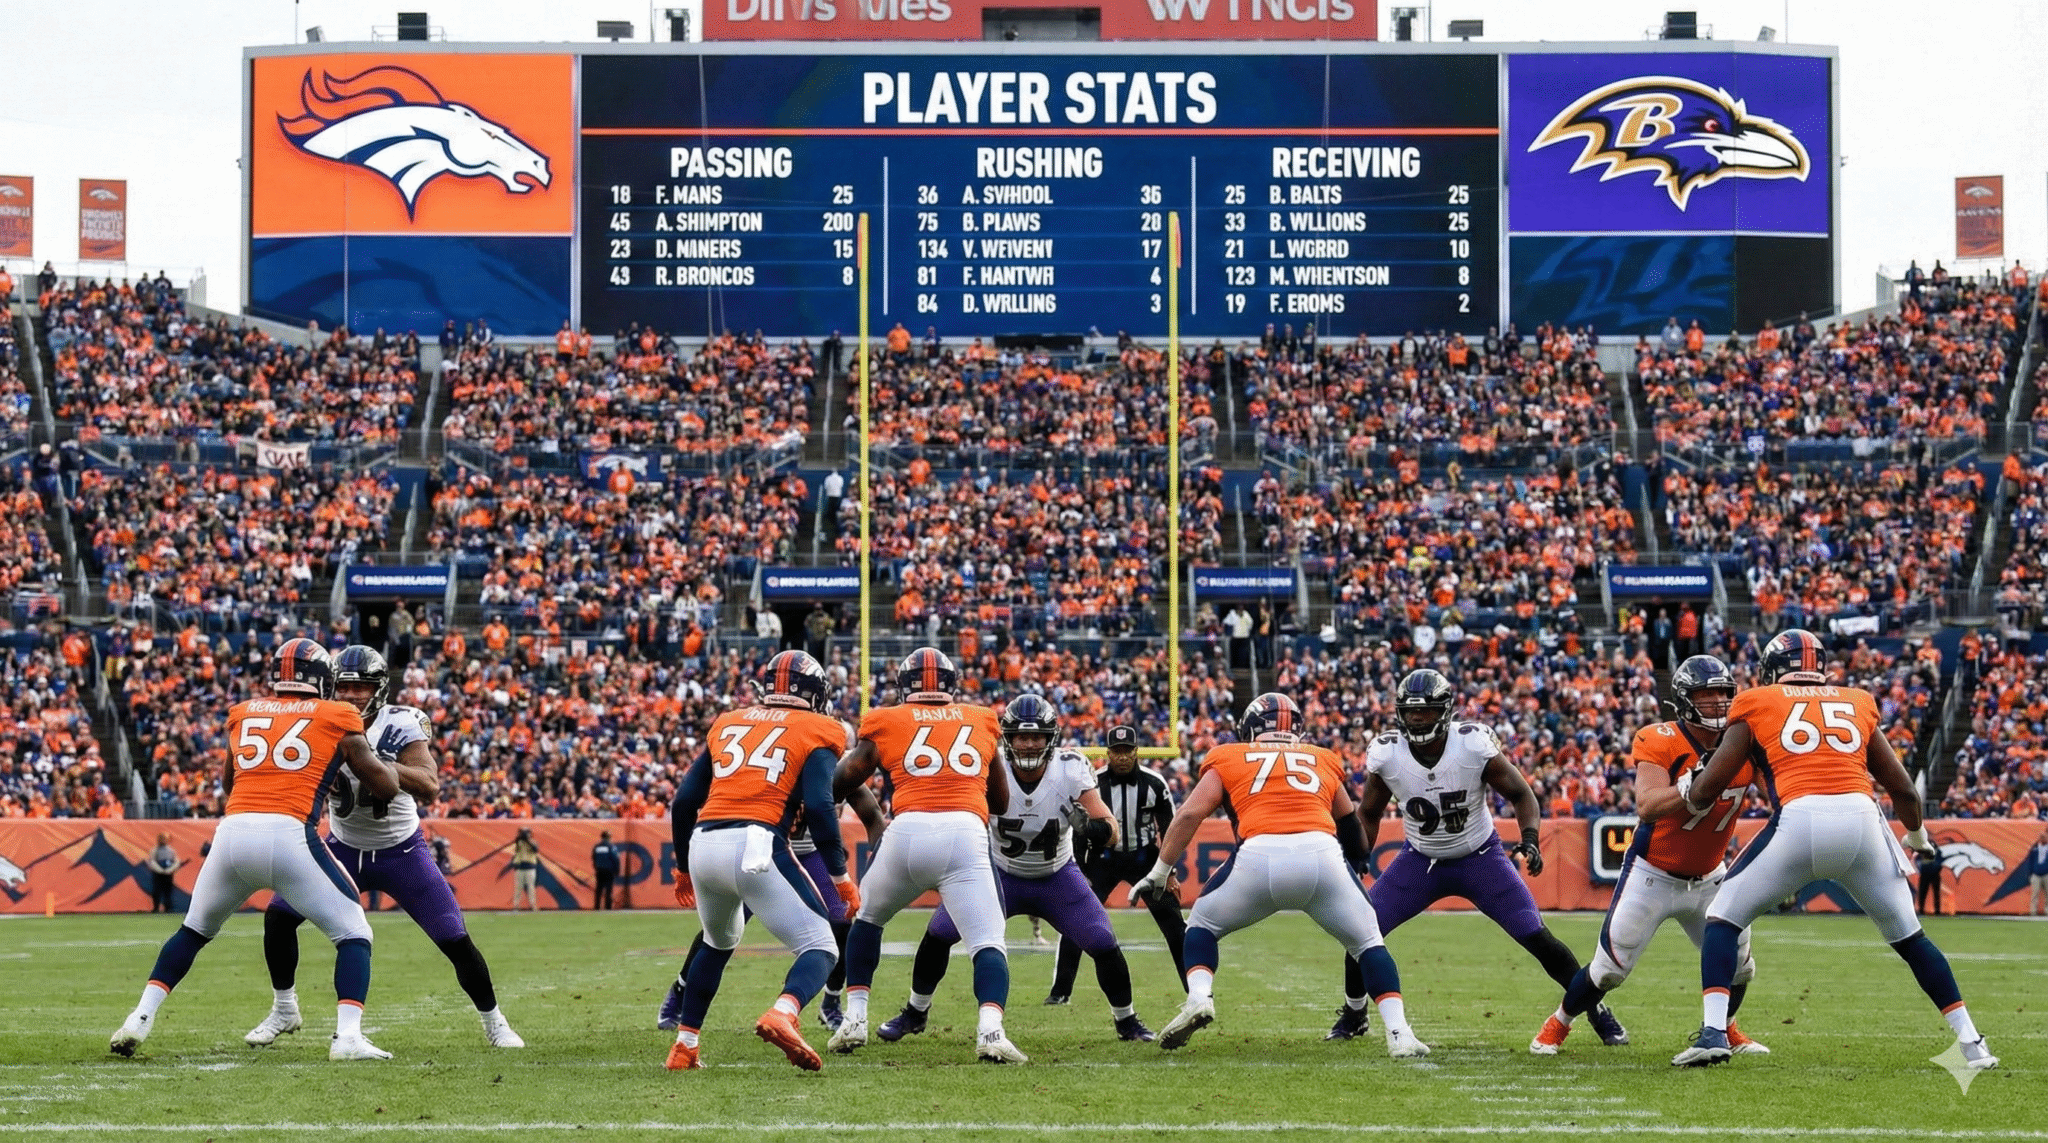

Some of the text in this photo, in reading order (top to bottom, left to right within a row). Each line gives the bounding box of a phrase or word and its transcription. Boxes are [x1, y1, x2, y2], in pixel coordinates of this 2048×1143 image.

[862, 71, 1218, 125] PLAYER STATS
[1598, 93, 1683, 147] B
[670, 146, 793, 179] PASSING
[977, 146, 1103, 178] RUSHING
[1272, 146, 1421, 178] RECEIVING
[611, 185, 854, 205] 18 F. MANS 25
[917, 185, 939, 205] 36
[962, 185, 980, 205] A.
[1224, 185, 1470, 205] 25 B. BALTS 25
[610, 212, 854, 232] 45 A. SHIMPTON 200
[917, 212, 939, 232] 75
[962, 212, 980, 232] B.
[983, 212, 1041, 232] PLAWS
[1224, 212, 1246, 232] 33
[1269, 212, 1286, 232] B.
[1448, 212, 1470, 232] 25
[610, 239, 631, 259] 23
[655, 239, 673, 259] D.
[833, 239, 854, 259] 15
[918, 239, 949, 259] 134
[962, 239, 978, 259] V.
[1141, 239, 1162, 259] 17
[1225, 239, 1244, 259] 21
[1270, 239, 1285, 259] L.
[1449, 239, 1470, 259] 10
[610, 266, 854, 286] 43 R. BRONCOS 8
[917, 266, 937, 286] 81
[963, 266, 977, 286] F.
[1150, 266, 1162, 286] 4
[1225, 266, 1256, 286] 123
[1269, 266, 1290, 286] M.
[1458, 266, 1470, 286] 8
[917, 293, 939, 313] 84
[963, 293, 980, 313] D.
[1150, 293, 1161, 313] 3
[1225, 293, 1470, 313] 19 F. EROMS 2
[1780, 701, 1862, 754] 65
[236, 716, 313, 772] 56
[903, 725, 982, 777] 66
[713, 724, 788, 785] 34
[1244, 750, 1321, 795] 75
[1405, 789, 1470, 836] 95
[997, 817, 1061, 862] 54
